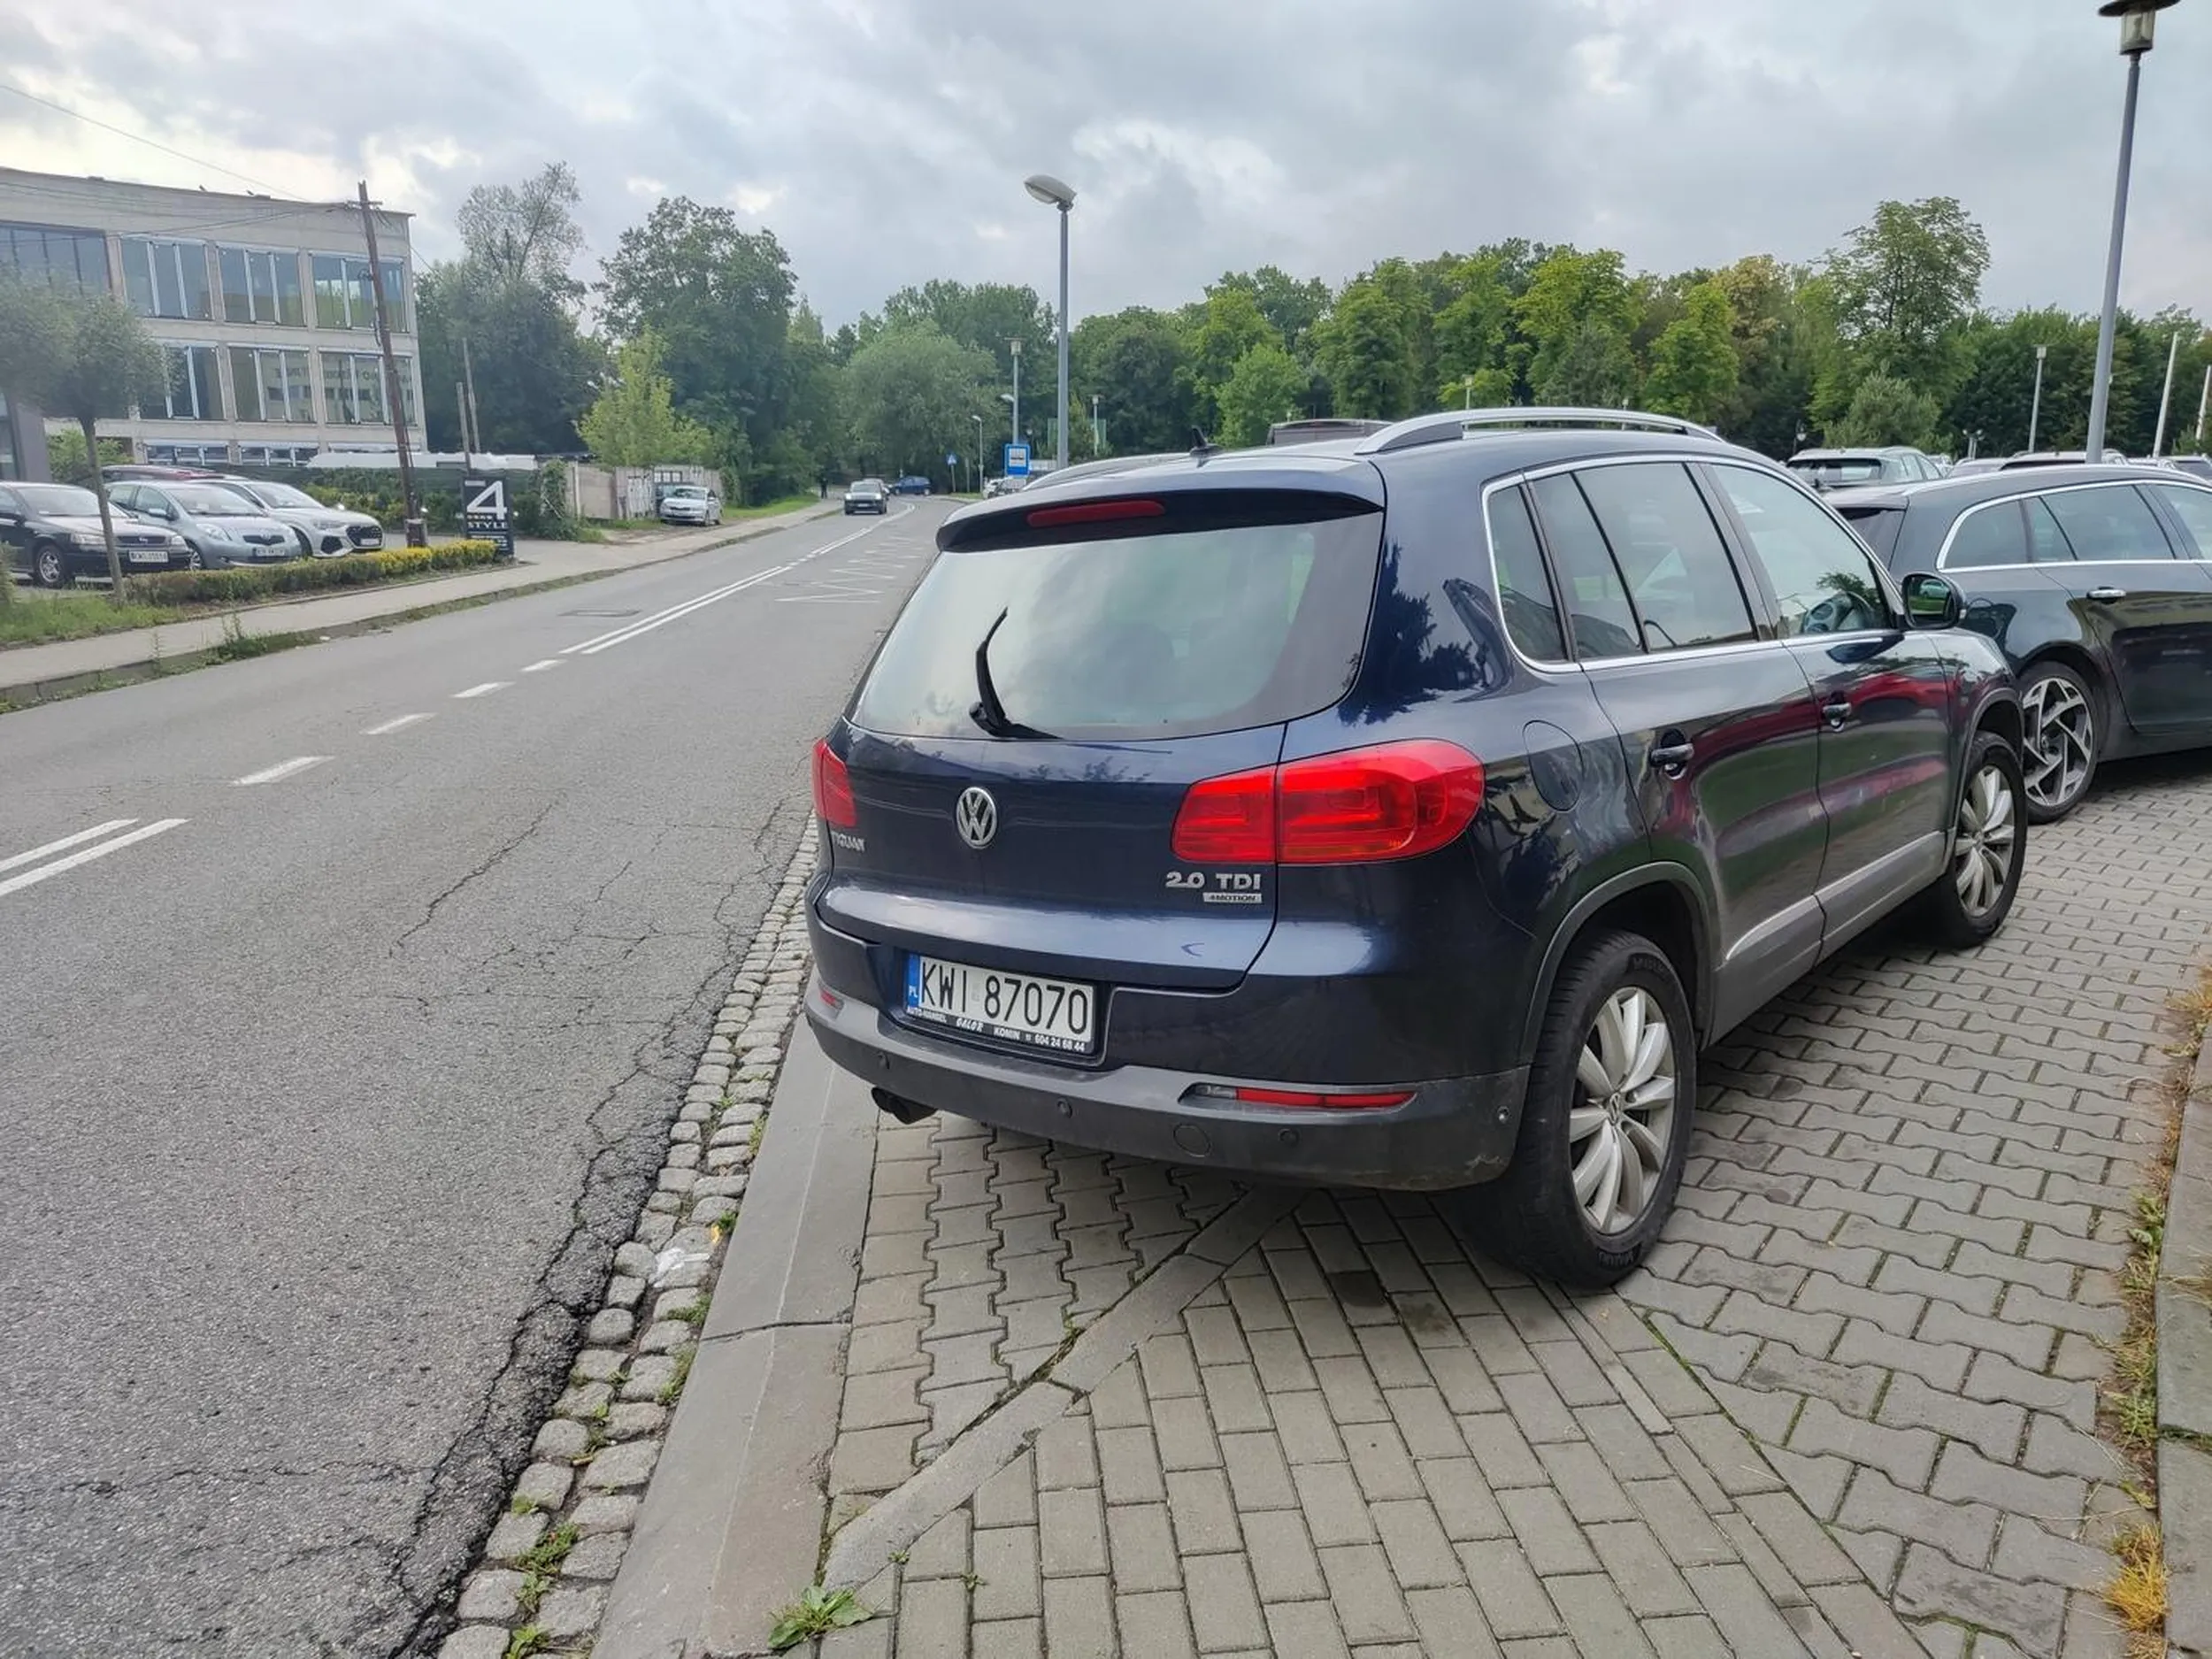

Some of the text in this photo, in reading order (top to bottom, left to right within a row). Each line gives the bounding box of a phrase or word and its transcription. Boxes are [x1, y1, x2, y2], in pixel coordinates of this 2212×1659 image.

[466, 480, 508, 520] 4
[1216, 873, 1261, 890] TDI
[1209, 893, 1256, 902] 4MOTION
[909, 985, 918, 998] PL
[922, 962, 1088, 1034] KWI 87070
[1050, 1037, 1061, 1048] 24
[1073, 1041, 1085, 1053] 44
